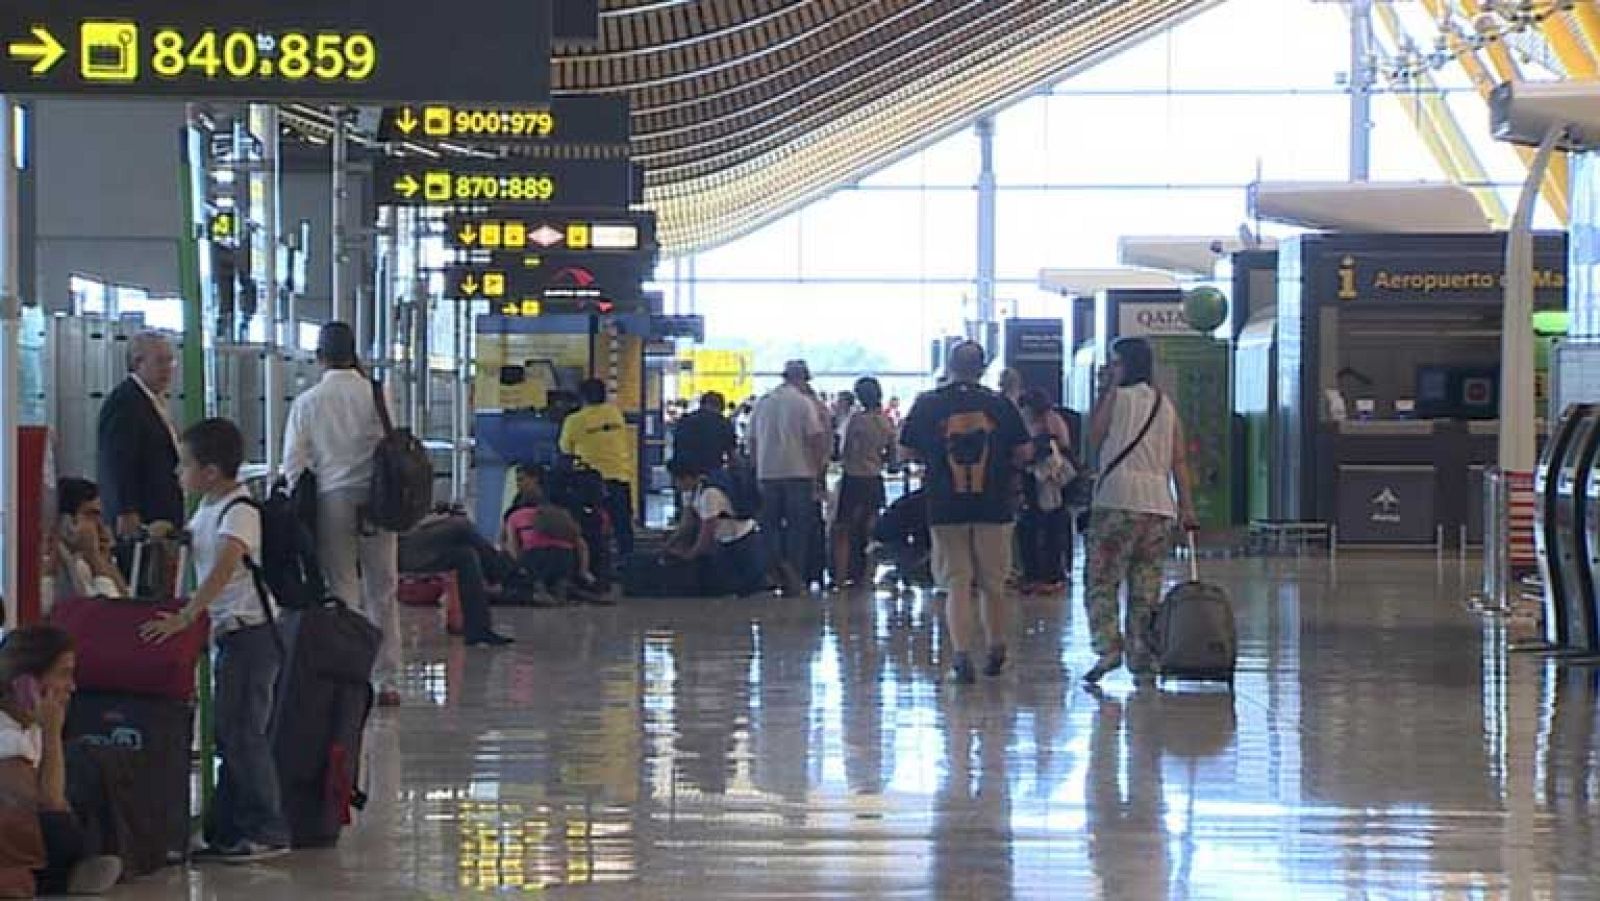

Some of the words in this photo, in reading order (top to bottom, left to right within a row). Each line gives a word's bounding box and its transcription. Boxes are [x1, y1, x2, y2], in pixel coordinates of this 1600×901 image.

[152, 30, 256, 78] 840
[278, 32, 376, 80] 859
[455, 111, 500, 133] 900
[511, 112, 553, 135] 979
[456, 176, 497, 198] 870
[510, 177, 553, 199] 889
[1373, 271, 1494, 293] Aeropuerto
[1137, 310, 1187, 328] QATA
